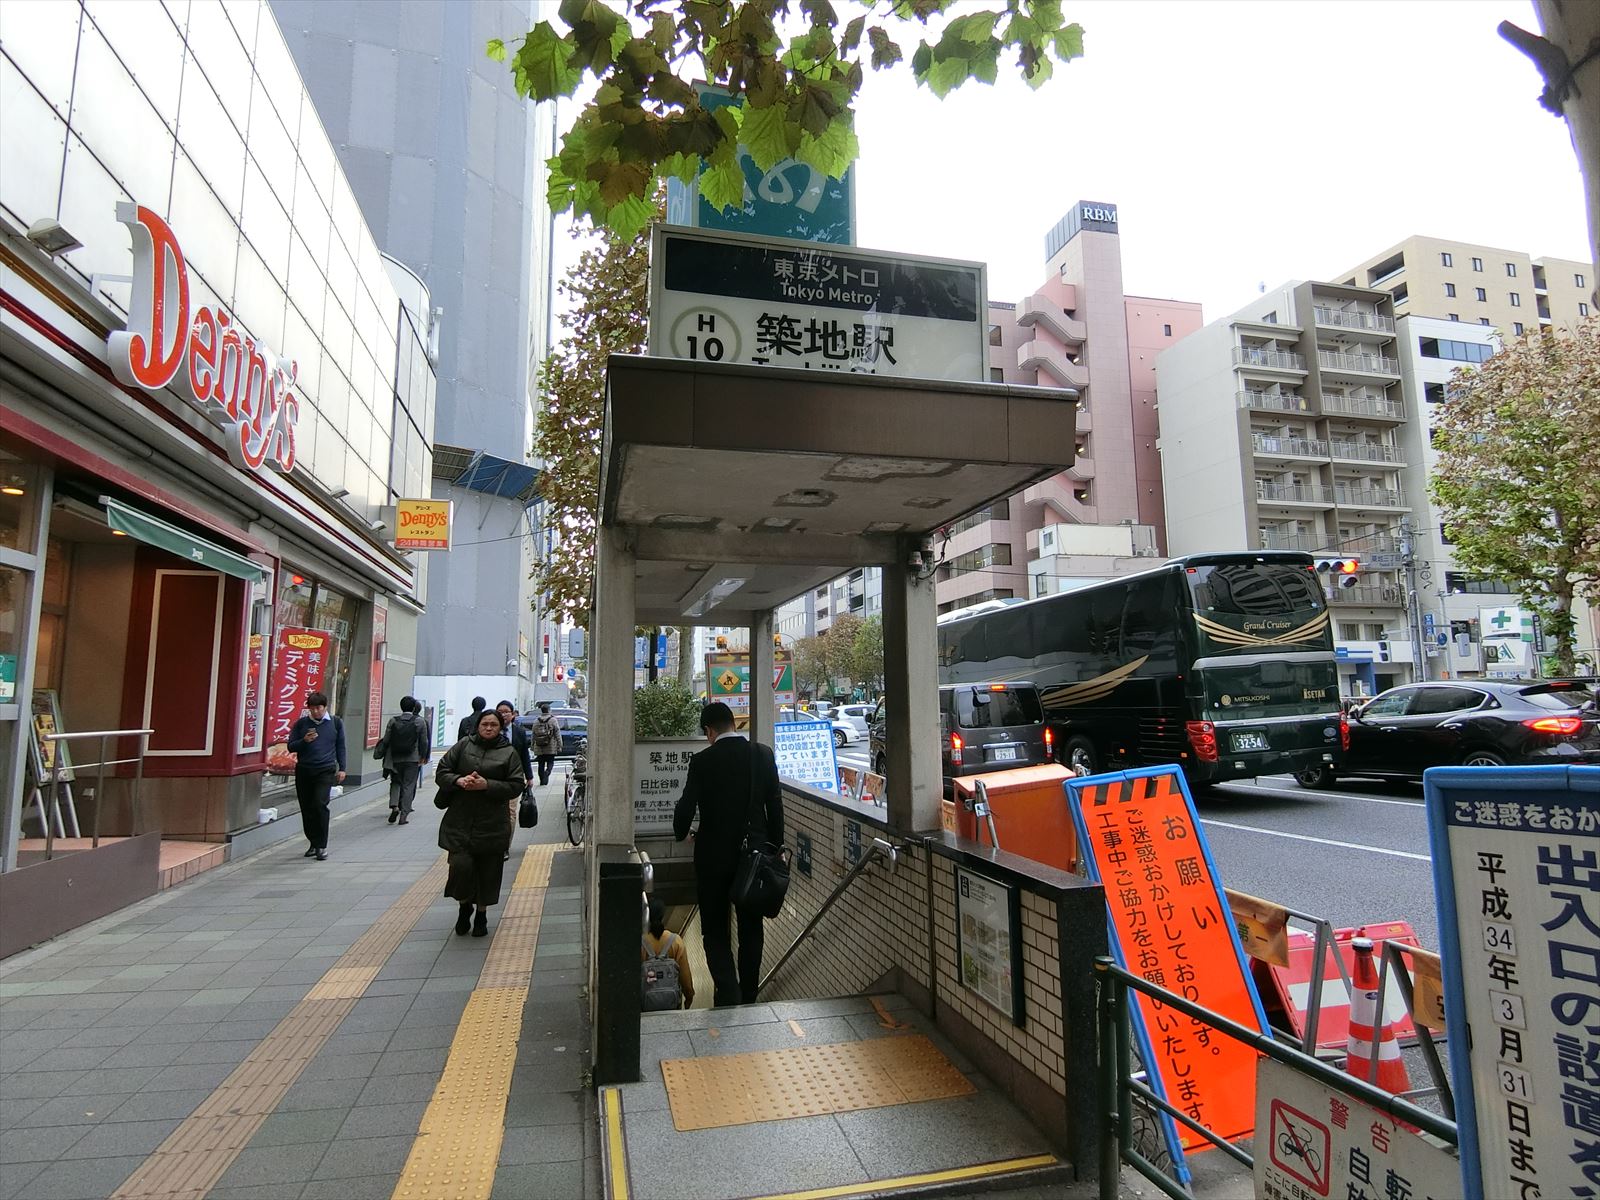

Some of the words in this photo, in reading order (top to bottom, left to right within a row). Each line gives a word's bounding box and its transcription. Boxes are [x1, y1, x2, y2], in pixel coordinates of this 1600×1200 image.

[1084, 207, 1117, 222] RBM
[773, 258, 880, 288] 東京メトロ
[780, 281, 825, 301] Tokyo
[828, 287, 873, 305] Metro
[698, 314, 715, 332] H
[129, 204, 300, 473] Denny's
[687, 336, 724, 362] 10
[756, 312, 897, 366] 築地駅
[400, 510, 448, 528] Denny's
[1244, 620, 1265, 632] Grand
[1266, 621, 1292, 630] Cruiser
[274, 650, 304, 732] デミグラス
[1234, 695, 1271, 703] MITSUKOSHI
[1239, 737, 1263, 749] 32-54
[641, 779, 680, 789] 日比谷線
[1162, 815, 1218, 930] お願い
[1536, 844, 1600, 1200] 出入口の設置を
[1329, 1097, 1391, 1154] 警告
[1350, 1147, 1434, 1200] 自転
